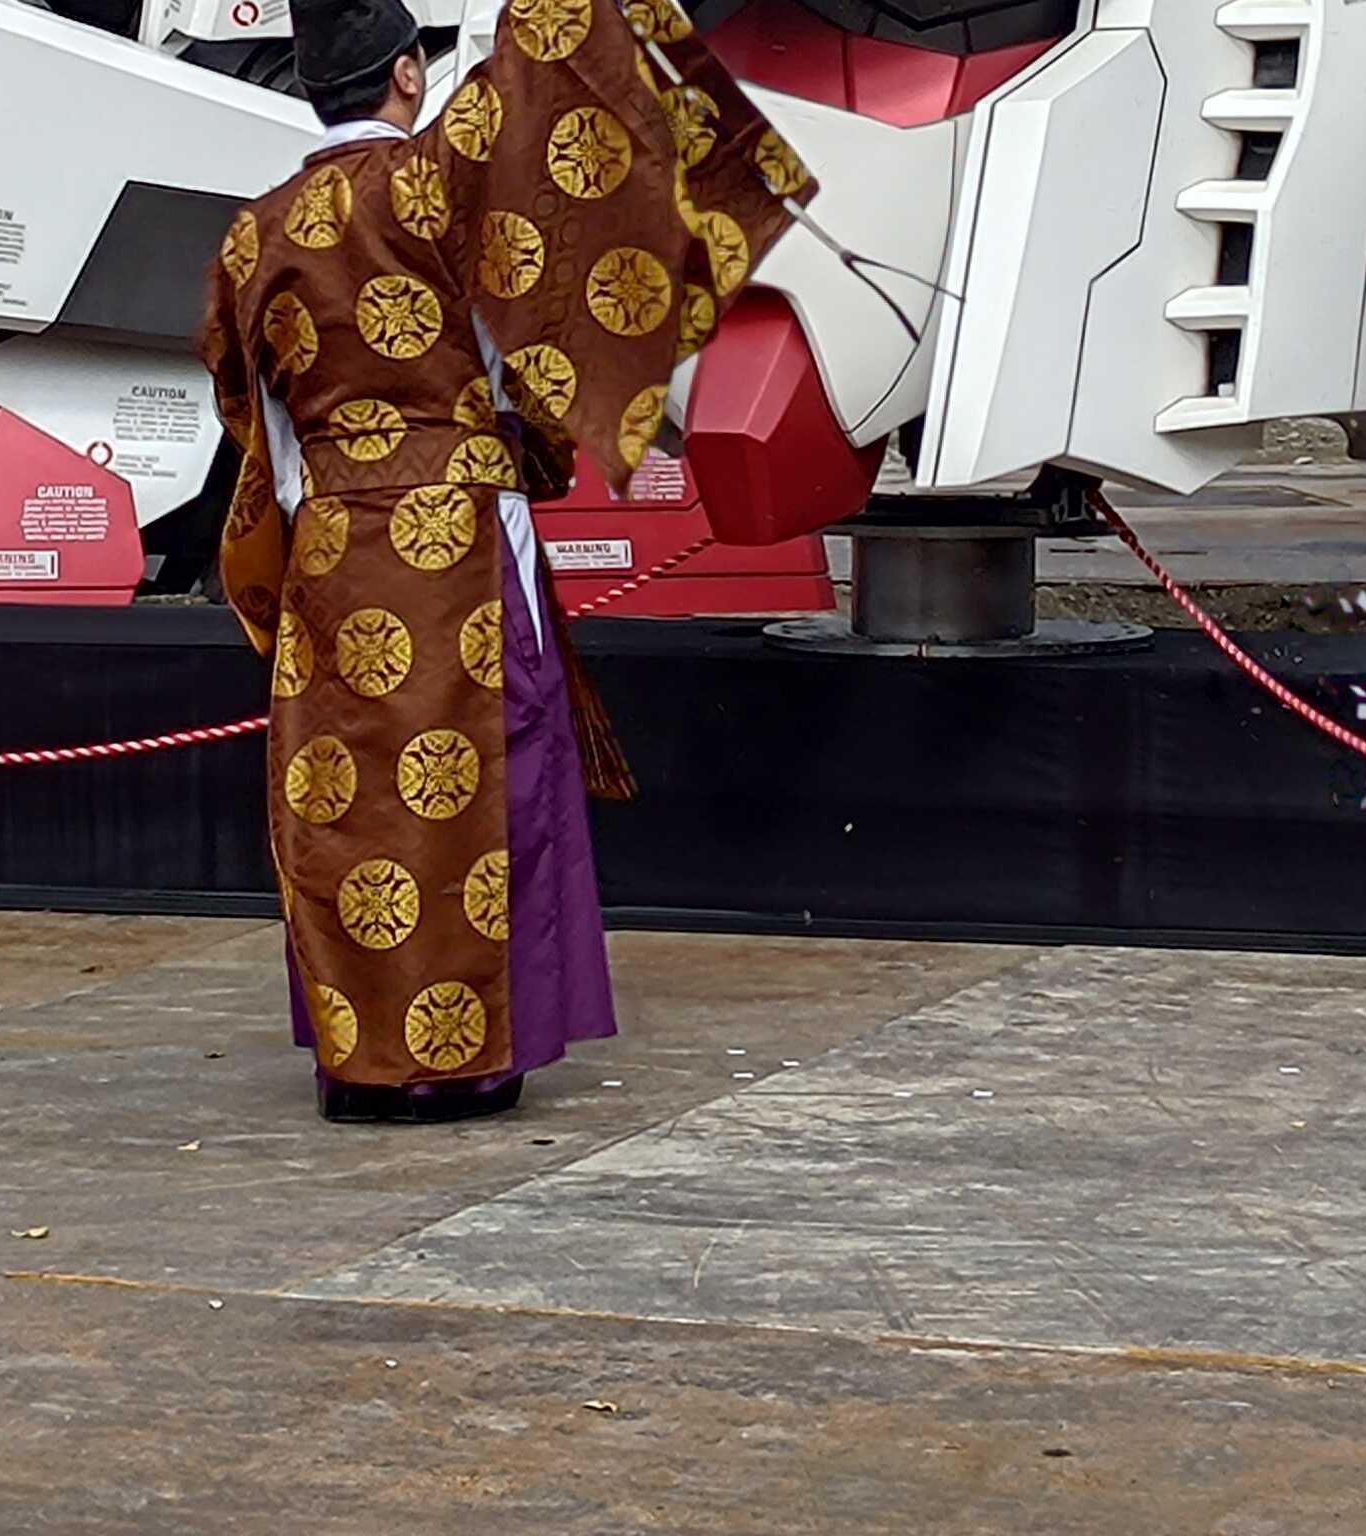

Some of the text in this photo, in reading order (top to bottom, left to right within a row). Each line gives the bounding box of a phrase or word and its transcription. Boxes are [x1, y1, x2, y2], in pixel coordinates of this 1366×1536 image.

[131, 385, 187, 399] CAUTION
[37, 485, 94, 499] CAUTION
[556, 543, 611, 554] WARNING
